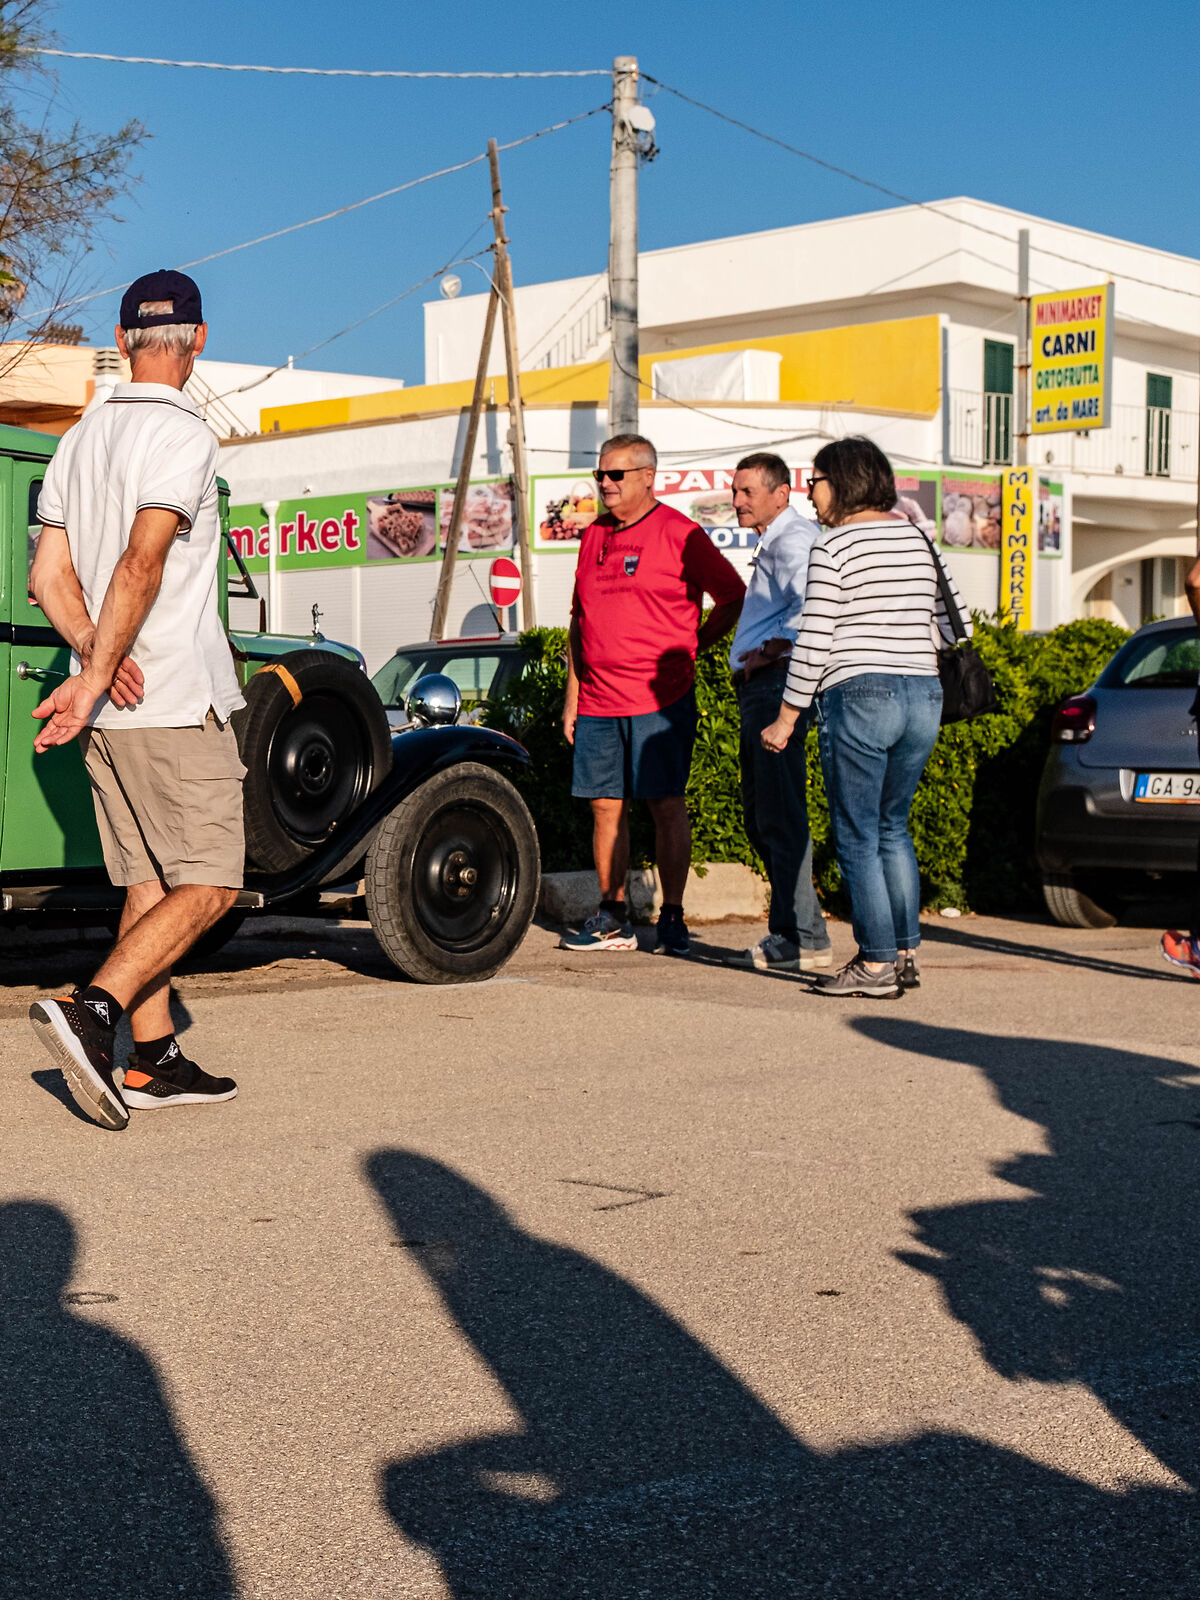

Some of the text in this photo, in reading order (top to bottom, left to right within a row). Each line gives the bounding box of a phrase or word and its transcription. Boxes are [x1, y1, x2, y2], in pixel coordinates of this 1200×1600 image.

[1035, 296, 1102, 326] MINIMARKET
[1042, 330, 1096, 357] CARNI
[1036, 364, 1099, 390] ORTOFRUTTA
[1036, 398, 1099, 422] art. da MARE
[1008, 471, 1029, 626] MINIMARKET
